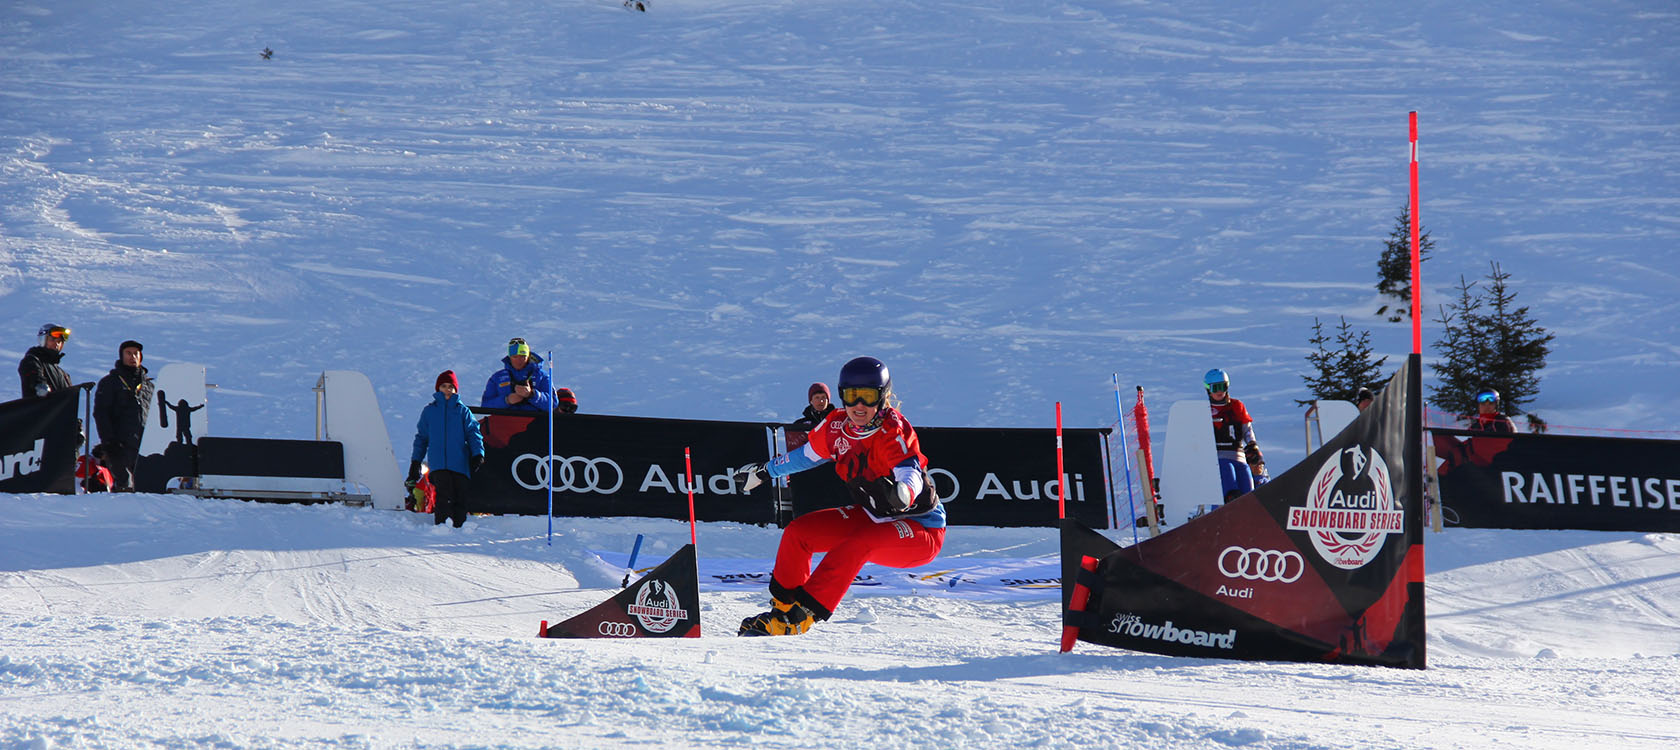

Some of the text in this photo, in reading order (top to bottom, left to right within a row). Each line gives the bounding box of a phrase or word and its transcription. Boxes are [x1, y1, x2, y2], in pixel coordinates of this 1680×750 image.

[639, 463, 752, 495] Aud
[975, 472, 1085, 501] Audi
[1330, 489, 1376, 509] Audi
[1501, 471, 1680, 511] RAIFFEISE
[1291, 509, 1402, 531] SNOWBOARD SERIES
[1215, 584, 1254, 599] Audi
[629, 605, 687, 618] SNOWBOARD SERIES
[646, 598, 669, 608] Audi
[1115, 612, 1142, 623] swiss
